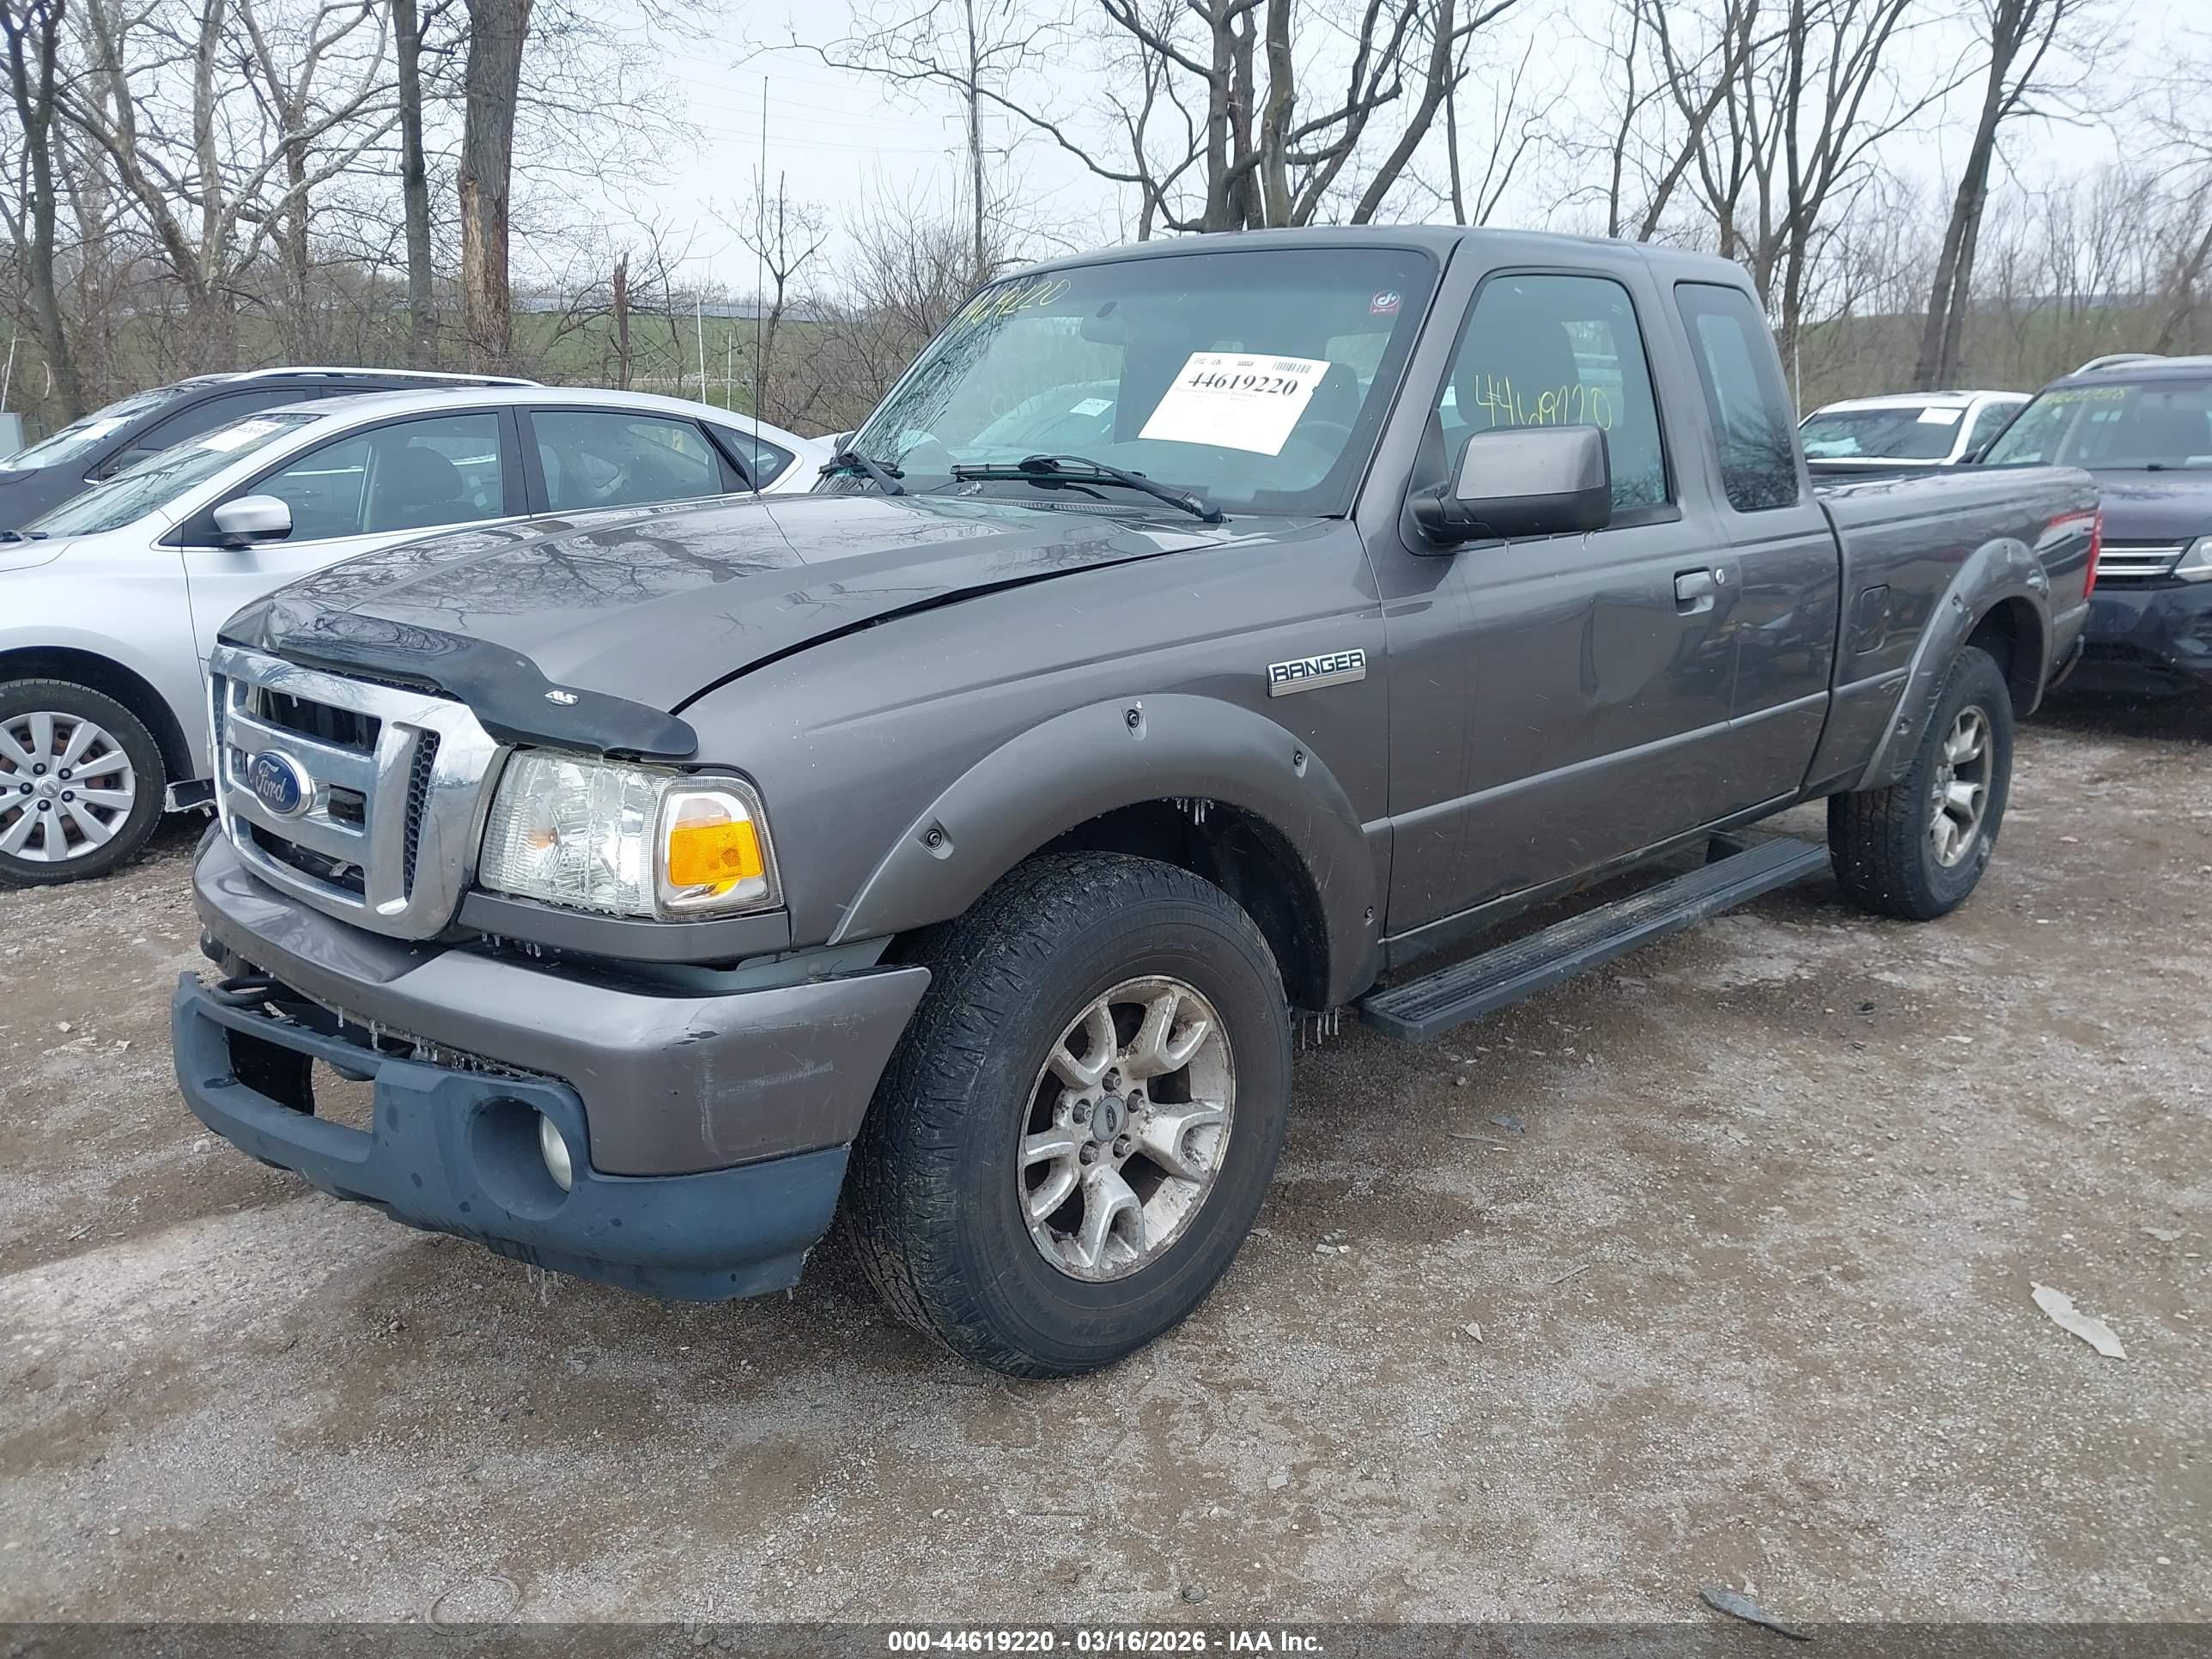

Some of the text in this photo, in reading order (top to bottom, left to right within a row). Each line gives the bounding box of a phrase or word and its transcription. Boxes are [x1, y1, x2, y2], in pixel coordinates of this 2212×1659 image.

[1188, 372, 1297, 396] 44619220
[1273, 653, 1364, 682] RANGER
[256, 761, 286, 802] Ford
